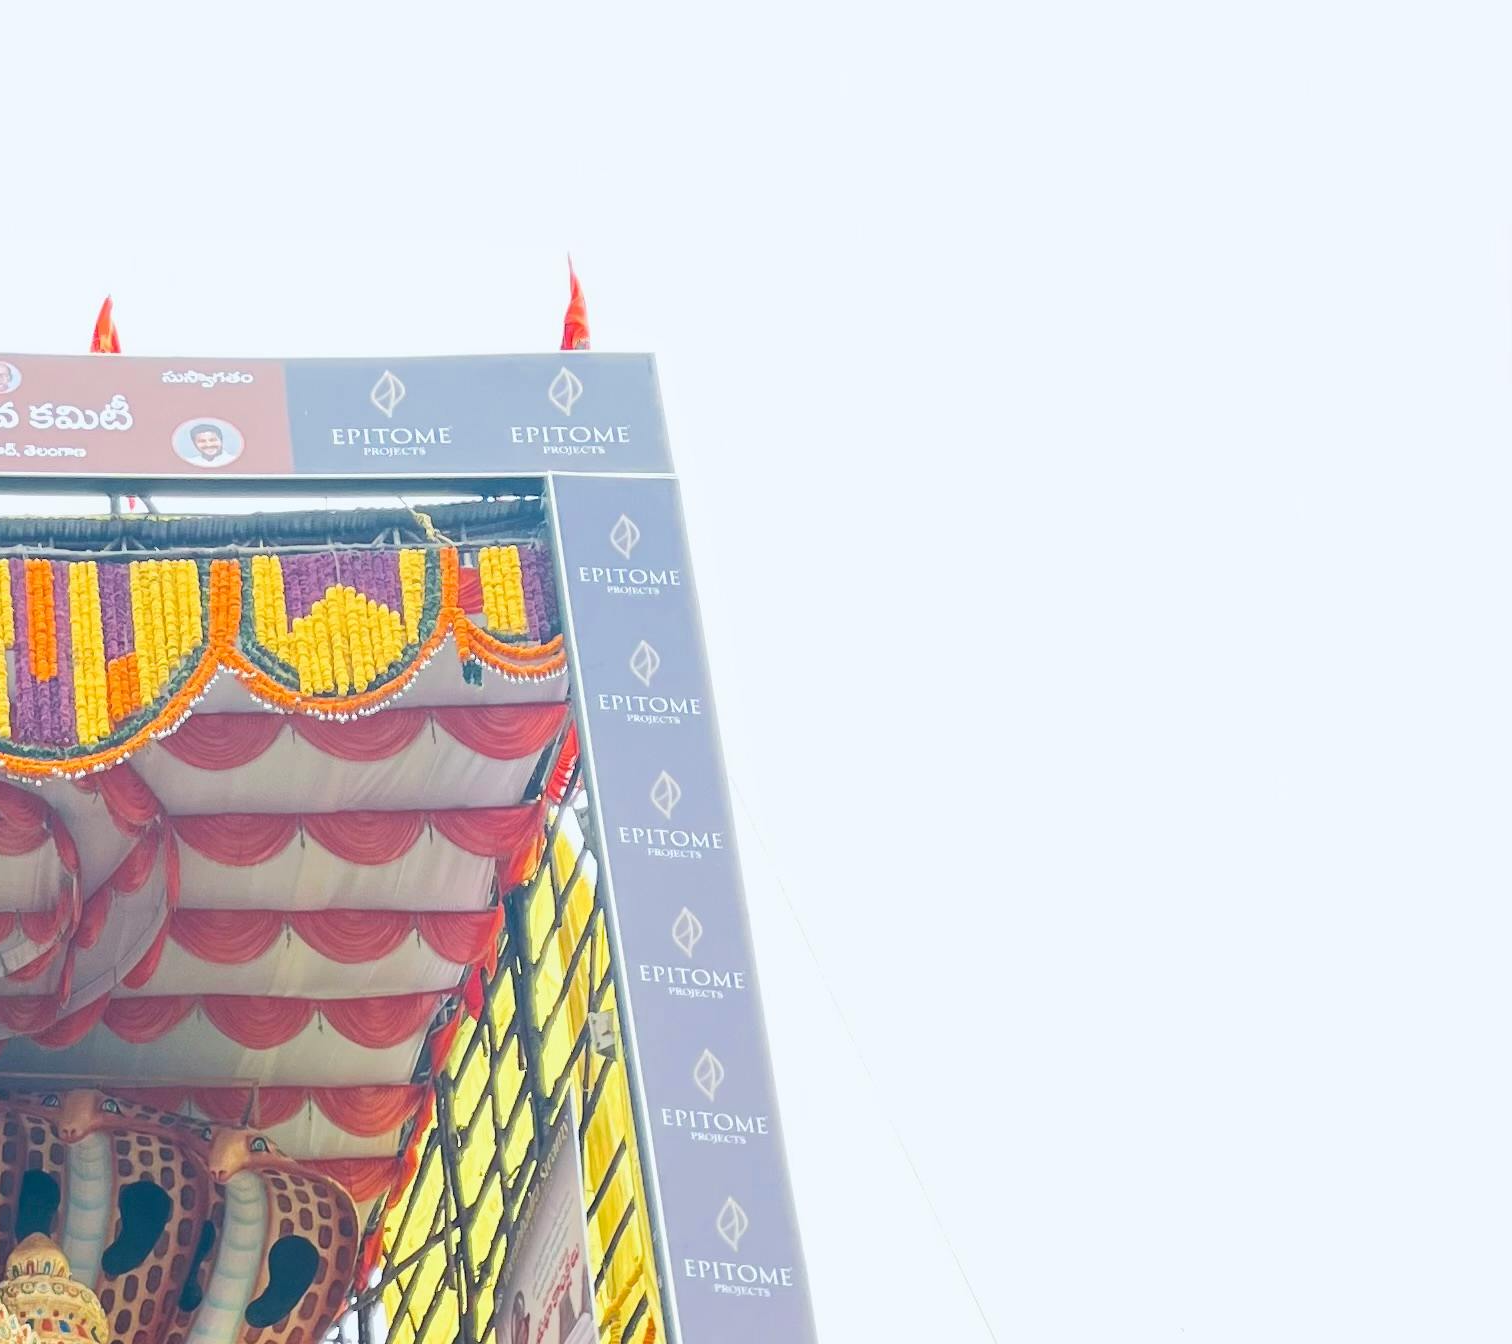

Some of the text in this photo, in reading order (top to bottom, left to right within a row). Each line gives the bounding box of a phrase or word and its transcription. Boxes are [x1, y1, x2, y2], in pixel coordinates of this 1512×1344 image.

[29, 394, 133, 430] కమిటీ
[332, 428, 451, 444] EPITOME
[512, 426, 629, 443] EPITOME
[365, 448, 426, 456] PROJECTS
[543, 446, 605, 455] PROJECTS
[580, 567, 680, 585] EPITOME
[607, 586, 659, 595] PROJECTS
